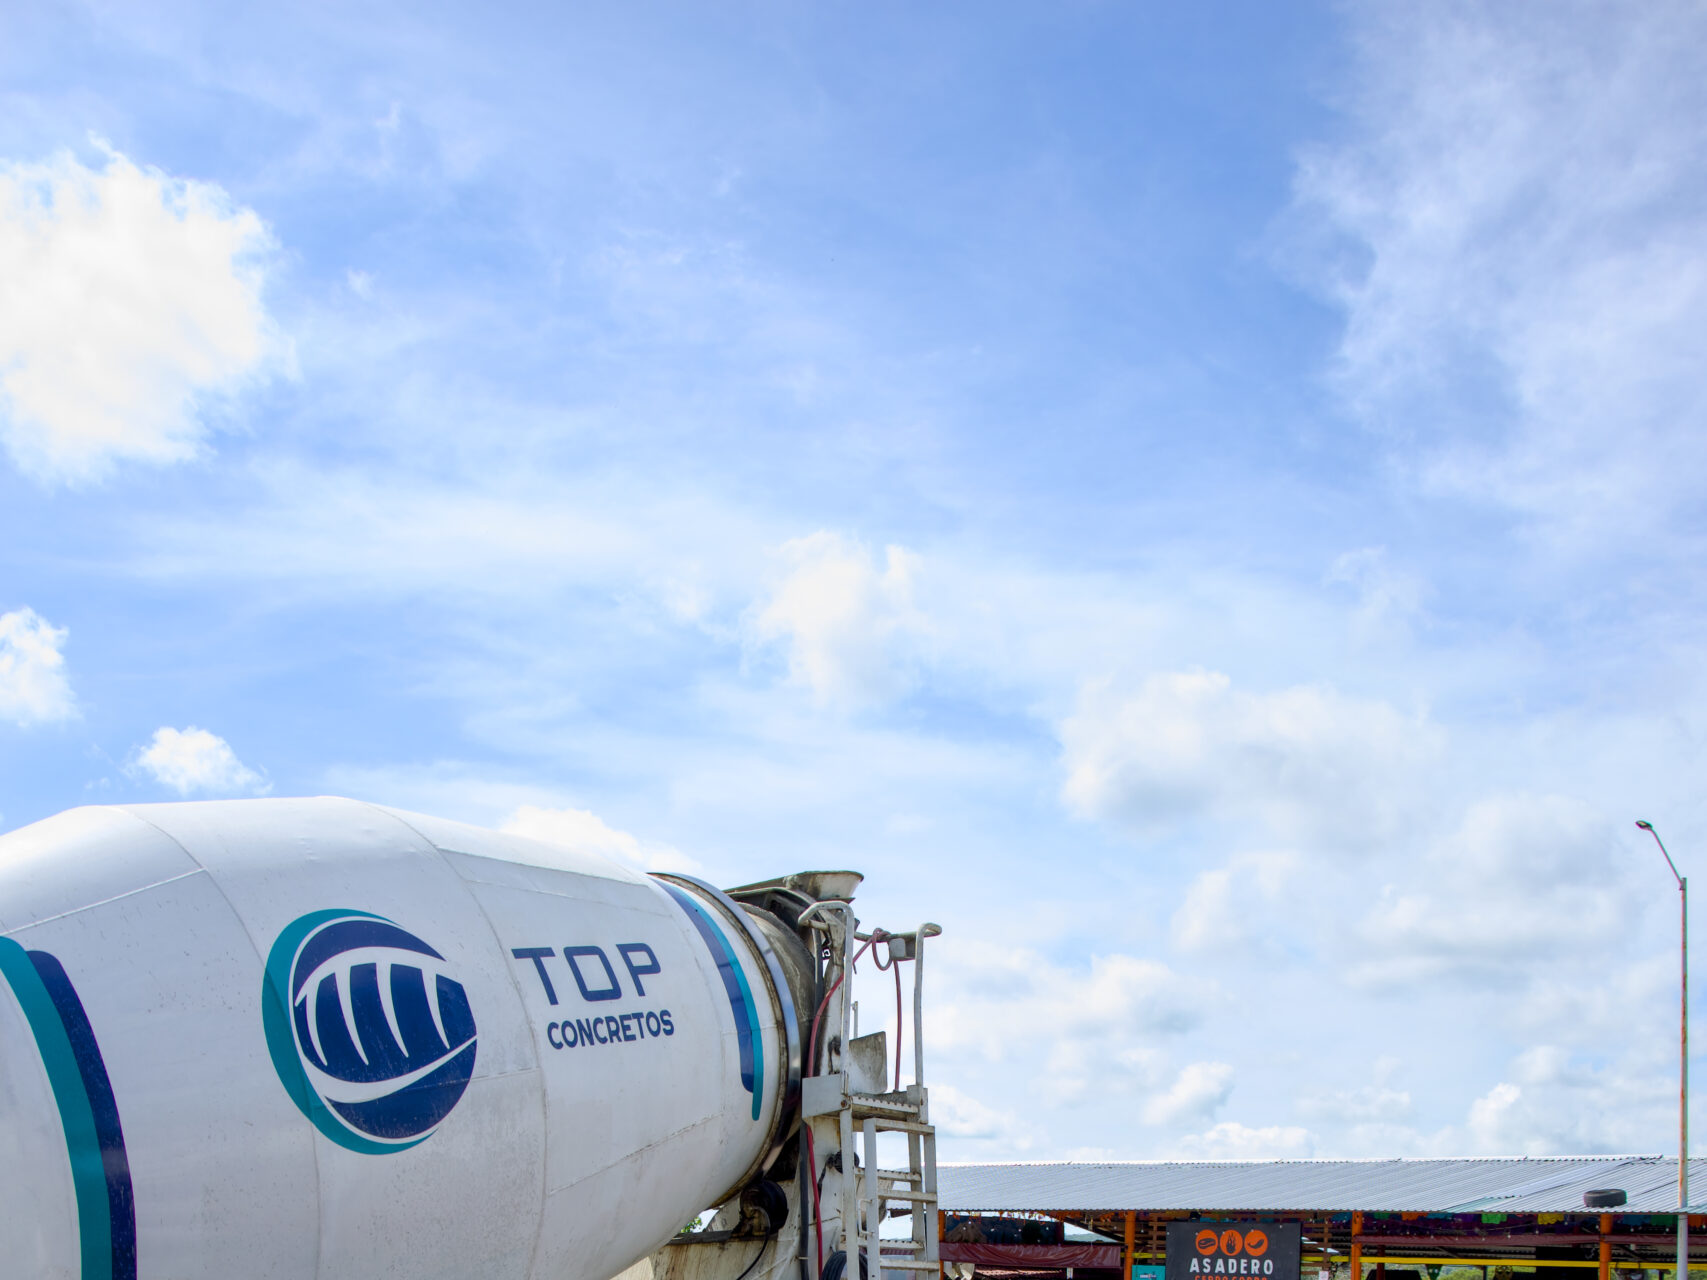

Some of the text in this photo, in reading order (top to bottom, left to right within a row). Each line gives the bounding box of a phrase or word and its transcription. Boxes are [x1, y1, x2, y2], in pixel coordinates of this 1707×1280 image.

[511, 943, 661, 1005] TOP
[547, 1009, 674, 1050] CONCRETOS
[1189, 1258, 1274, 1275] ASADERO
